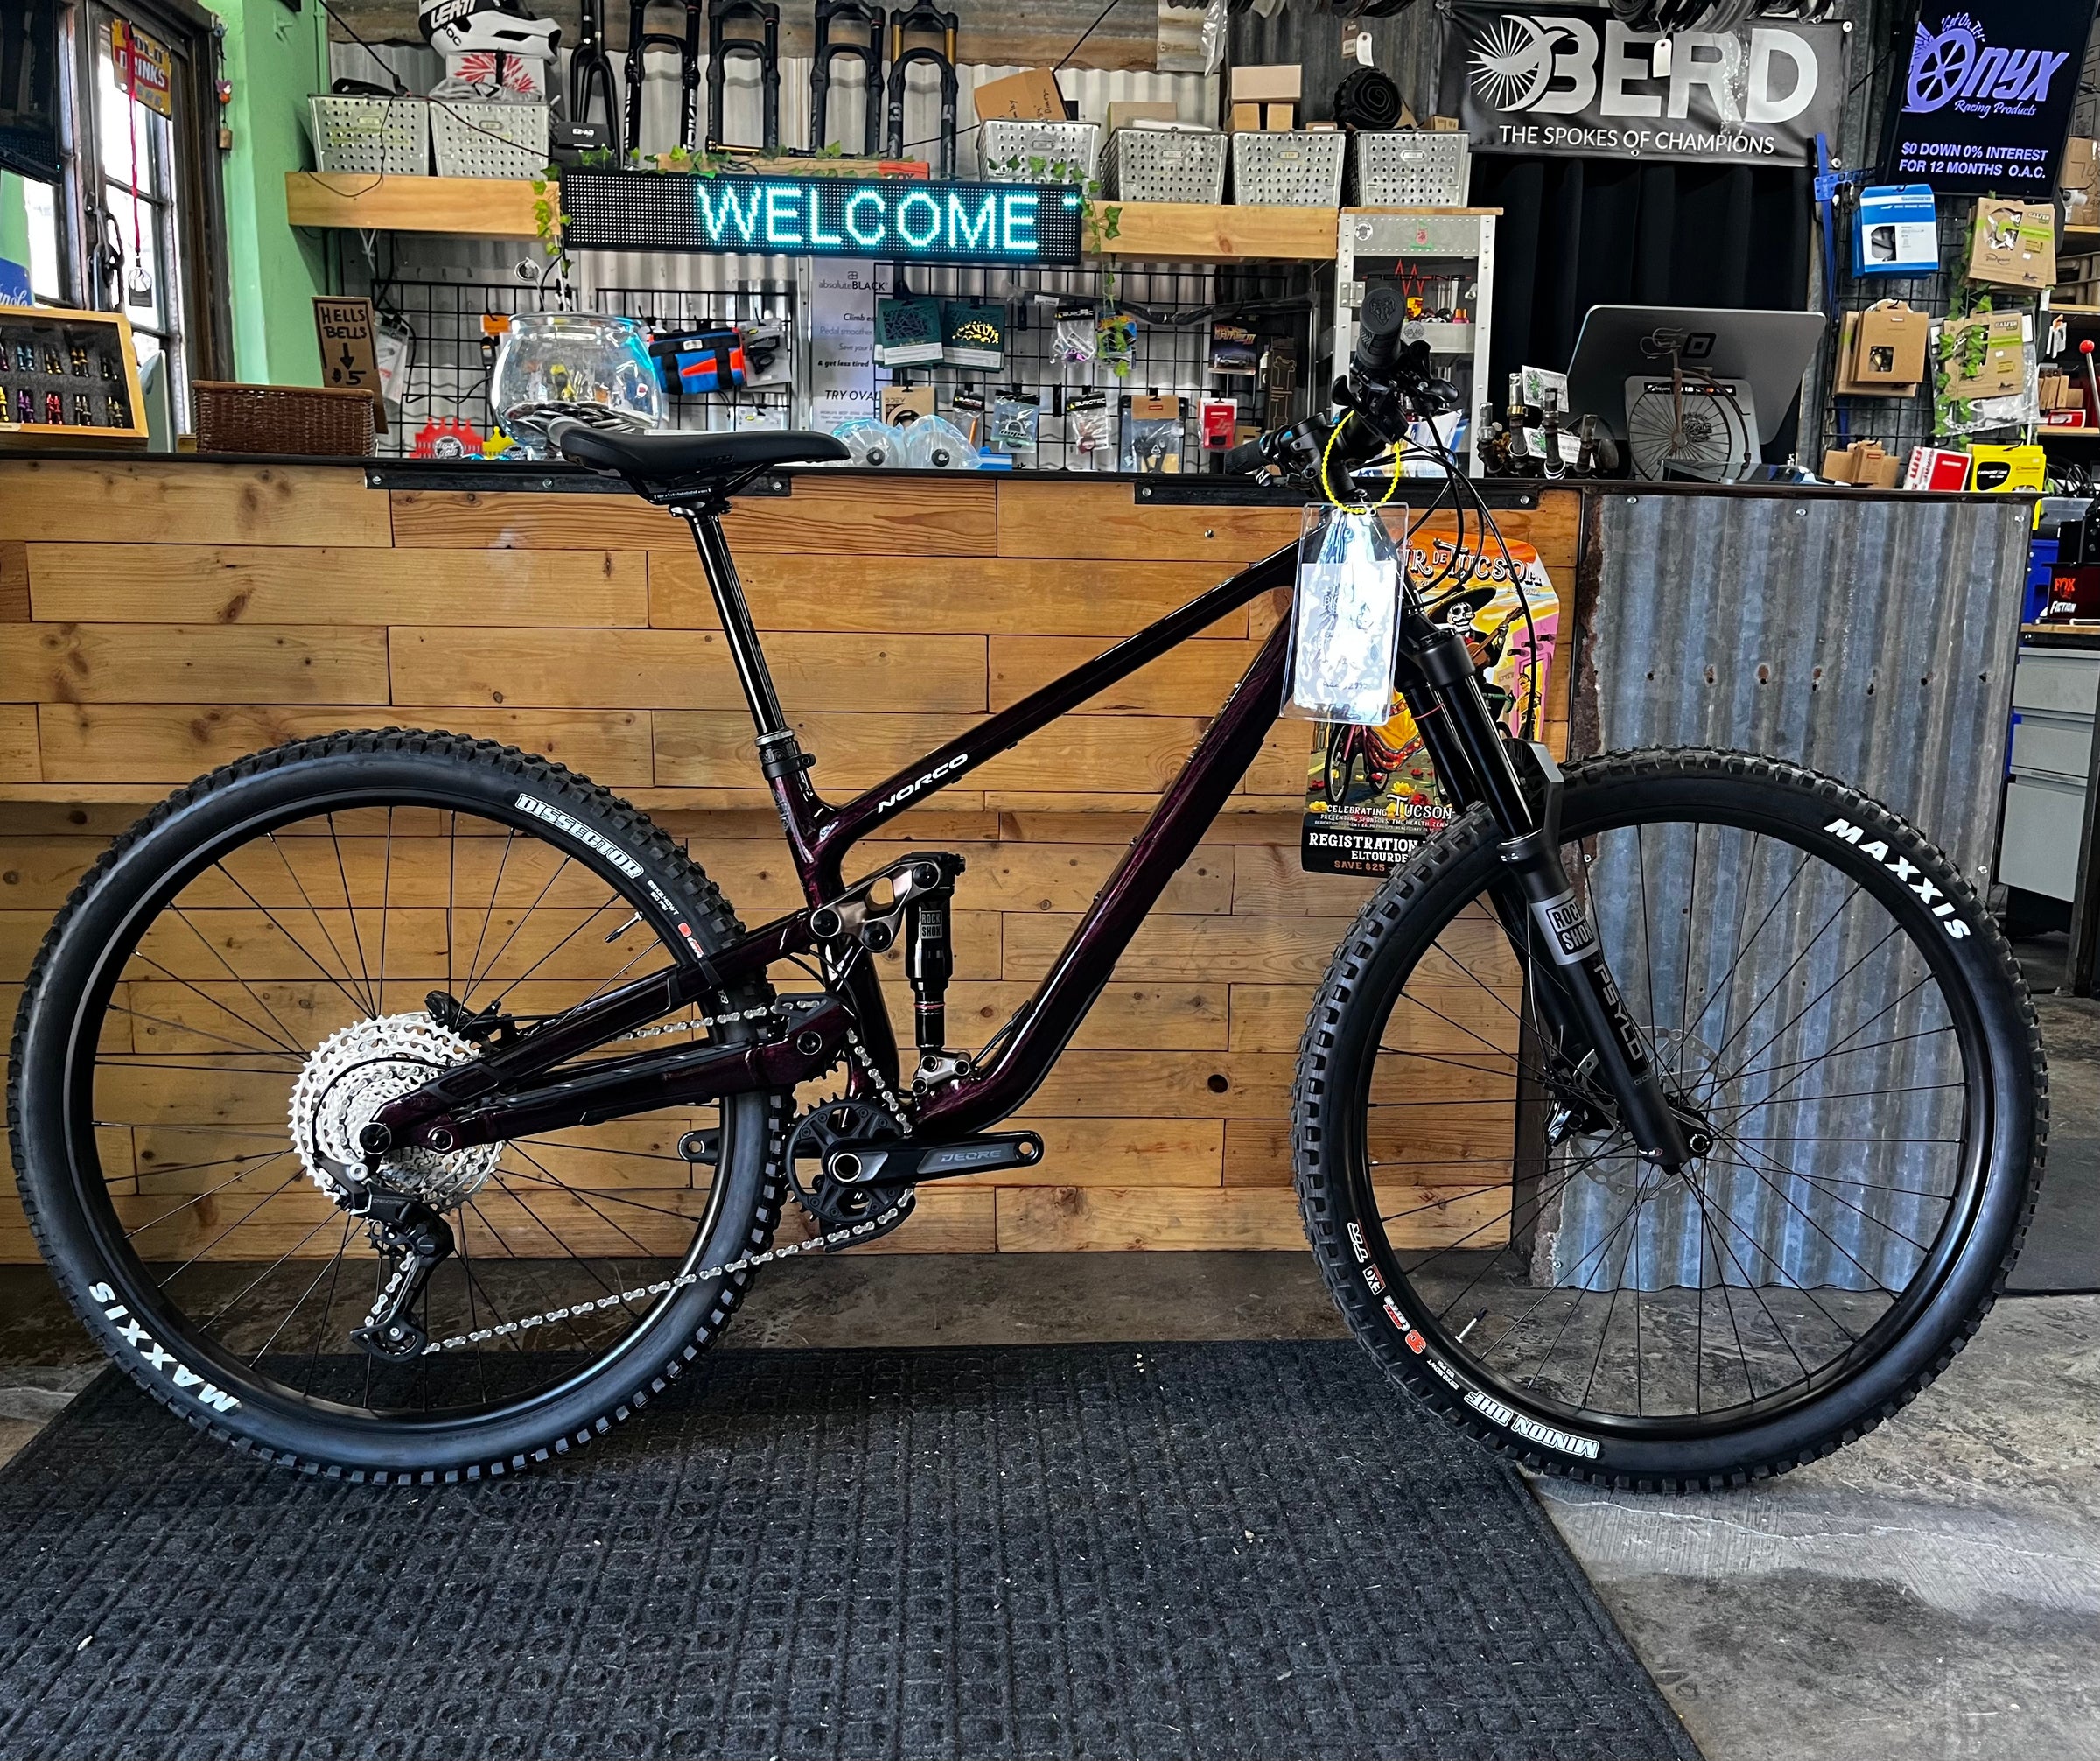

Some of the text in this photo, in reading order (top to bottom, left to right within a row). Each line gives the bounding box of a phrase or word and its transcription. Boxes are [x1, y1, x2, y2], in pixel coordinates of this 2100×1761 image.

[1526, 16, 1818, 123] BERD
[1955, 100, 2037, 118] Racing Products
[1499, 125, 1774, 155] THE SPOKES OF CHAMPIONS
[1901, 142, 2048, 161] $0 DOWN 0% INTEREST
[1899, 159, 2046, 178] FOR 12 MONTHS O.A.C.
[696, 184, 1040, 250] WELCOME
[320, 306, 366, 324] HELLS
[843, 313, 865, 322] Climb
[323, 326, 368, 340] BELLS
[819, 326, 840, 335] Pedal
[332, 367, 367, 385] $5
[825, 390, 847, 400] TRY
[1432, 551, 1447, 565] DE
[1433, 537, 1542, 585] TUCSON
[2054, 578, 2076, 592] FOX
[878, 754, 969, 814] NORCO
[1326, 794, 1452, 820] CELEBRATING TUCSON
[514, 793, 645, 880] DISSECTOR
[1309, 832, 1418, 852] REGISTRATION
[1334, 860, 1386, 872] SAVE $25
[1824, 818, 1970, 939] MAXXIS
[921, 910, 941, 924] ROCK
[1552, 902, 1586, 930] ROCK
[921, 925, 942, 937] SHOX
[1593, 964, 1643, 1061] PSYLO
[941, 1149, 1003, 1163] DEORE
[89, 1281, 241, 1412] MAXXIS
[1464, 1390, 1600, 1459] MINION DHF
